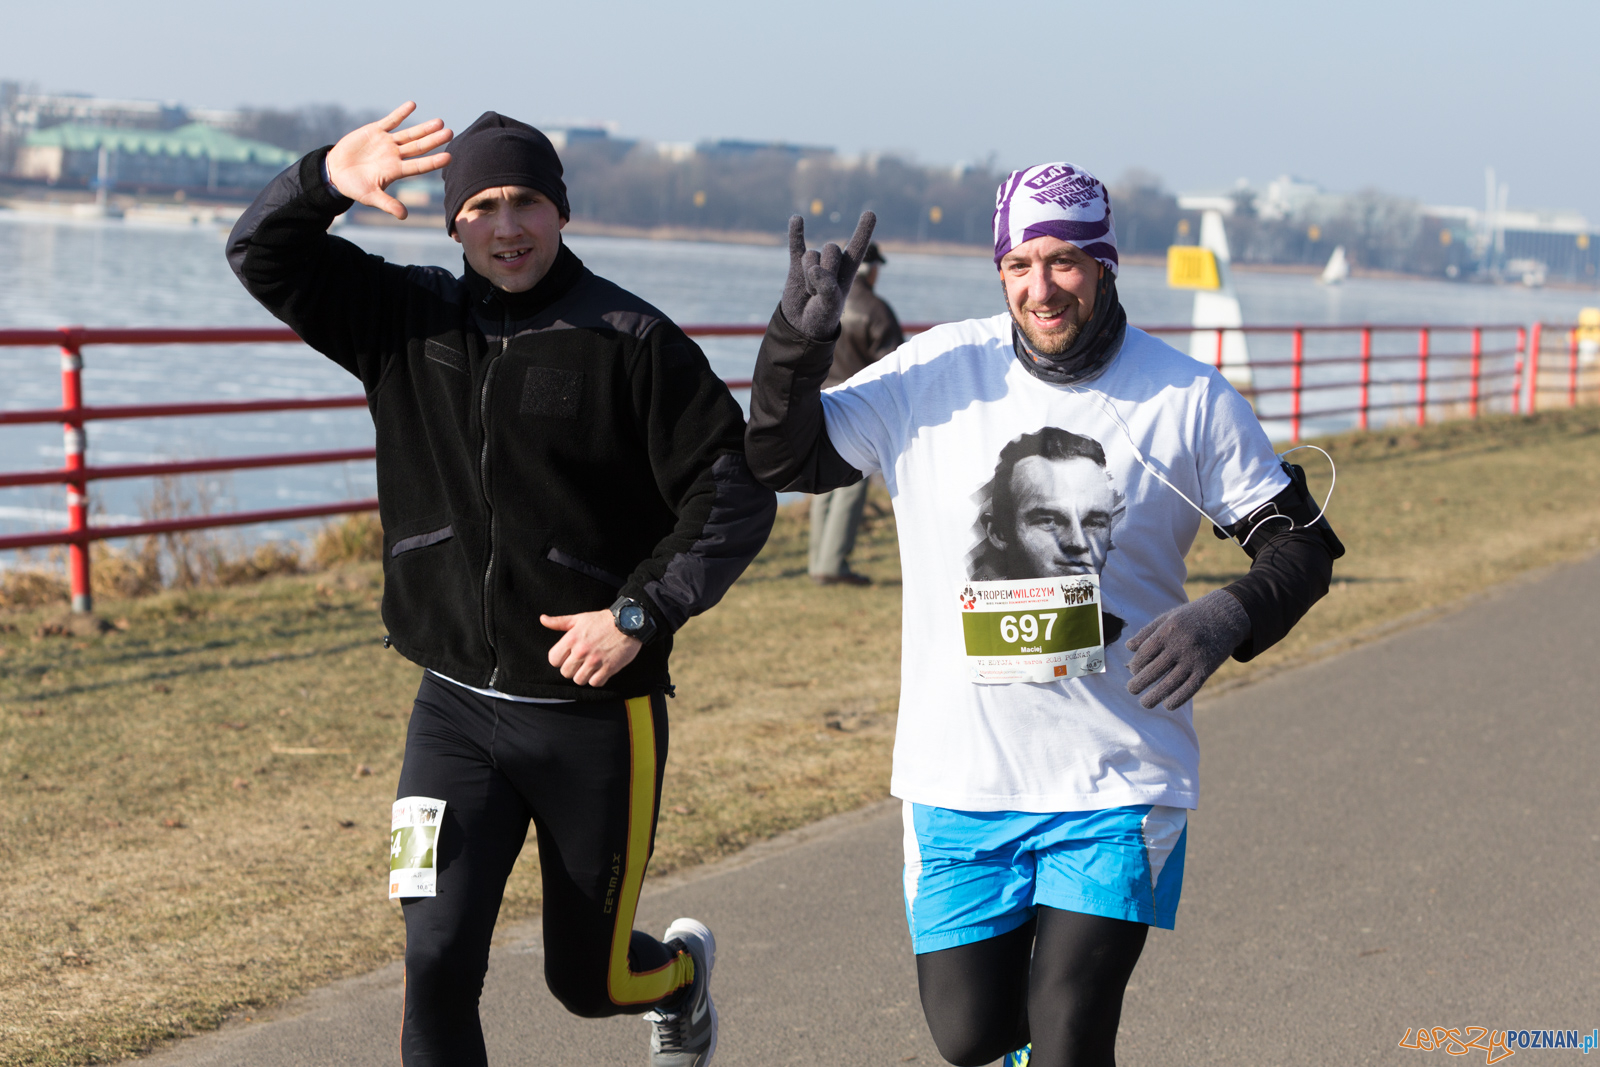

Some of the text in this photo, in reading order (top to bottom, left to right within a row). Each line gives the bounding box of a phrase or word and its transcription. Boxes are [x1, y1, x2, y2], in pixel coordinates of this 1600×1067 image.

[1032, 167, 1066, 186] PLAY
[1000, 613, 1058, 643] 697
[1020, 645, 1043, 653] Maciej
[1046, 656, 1062, 664] 2018
